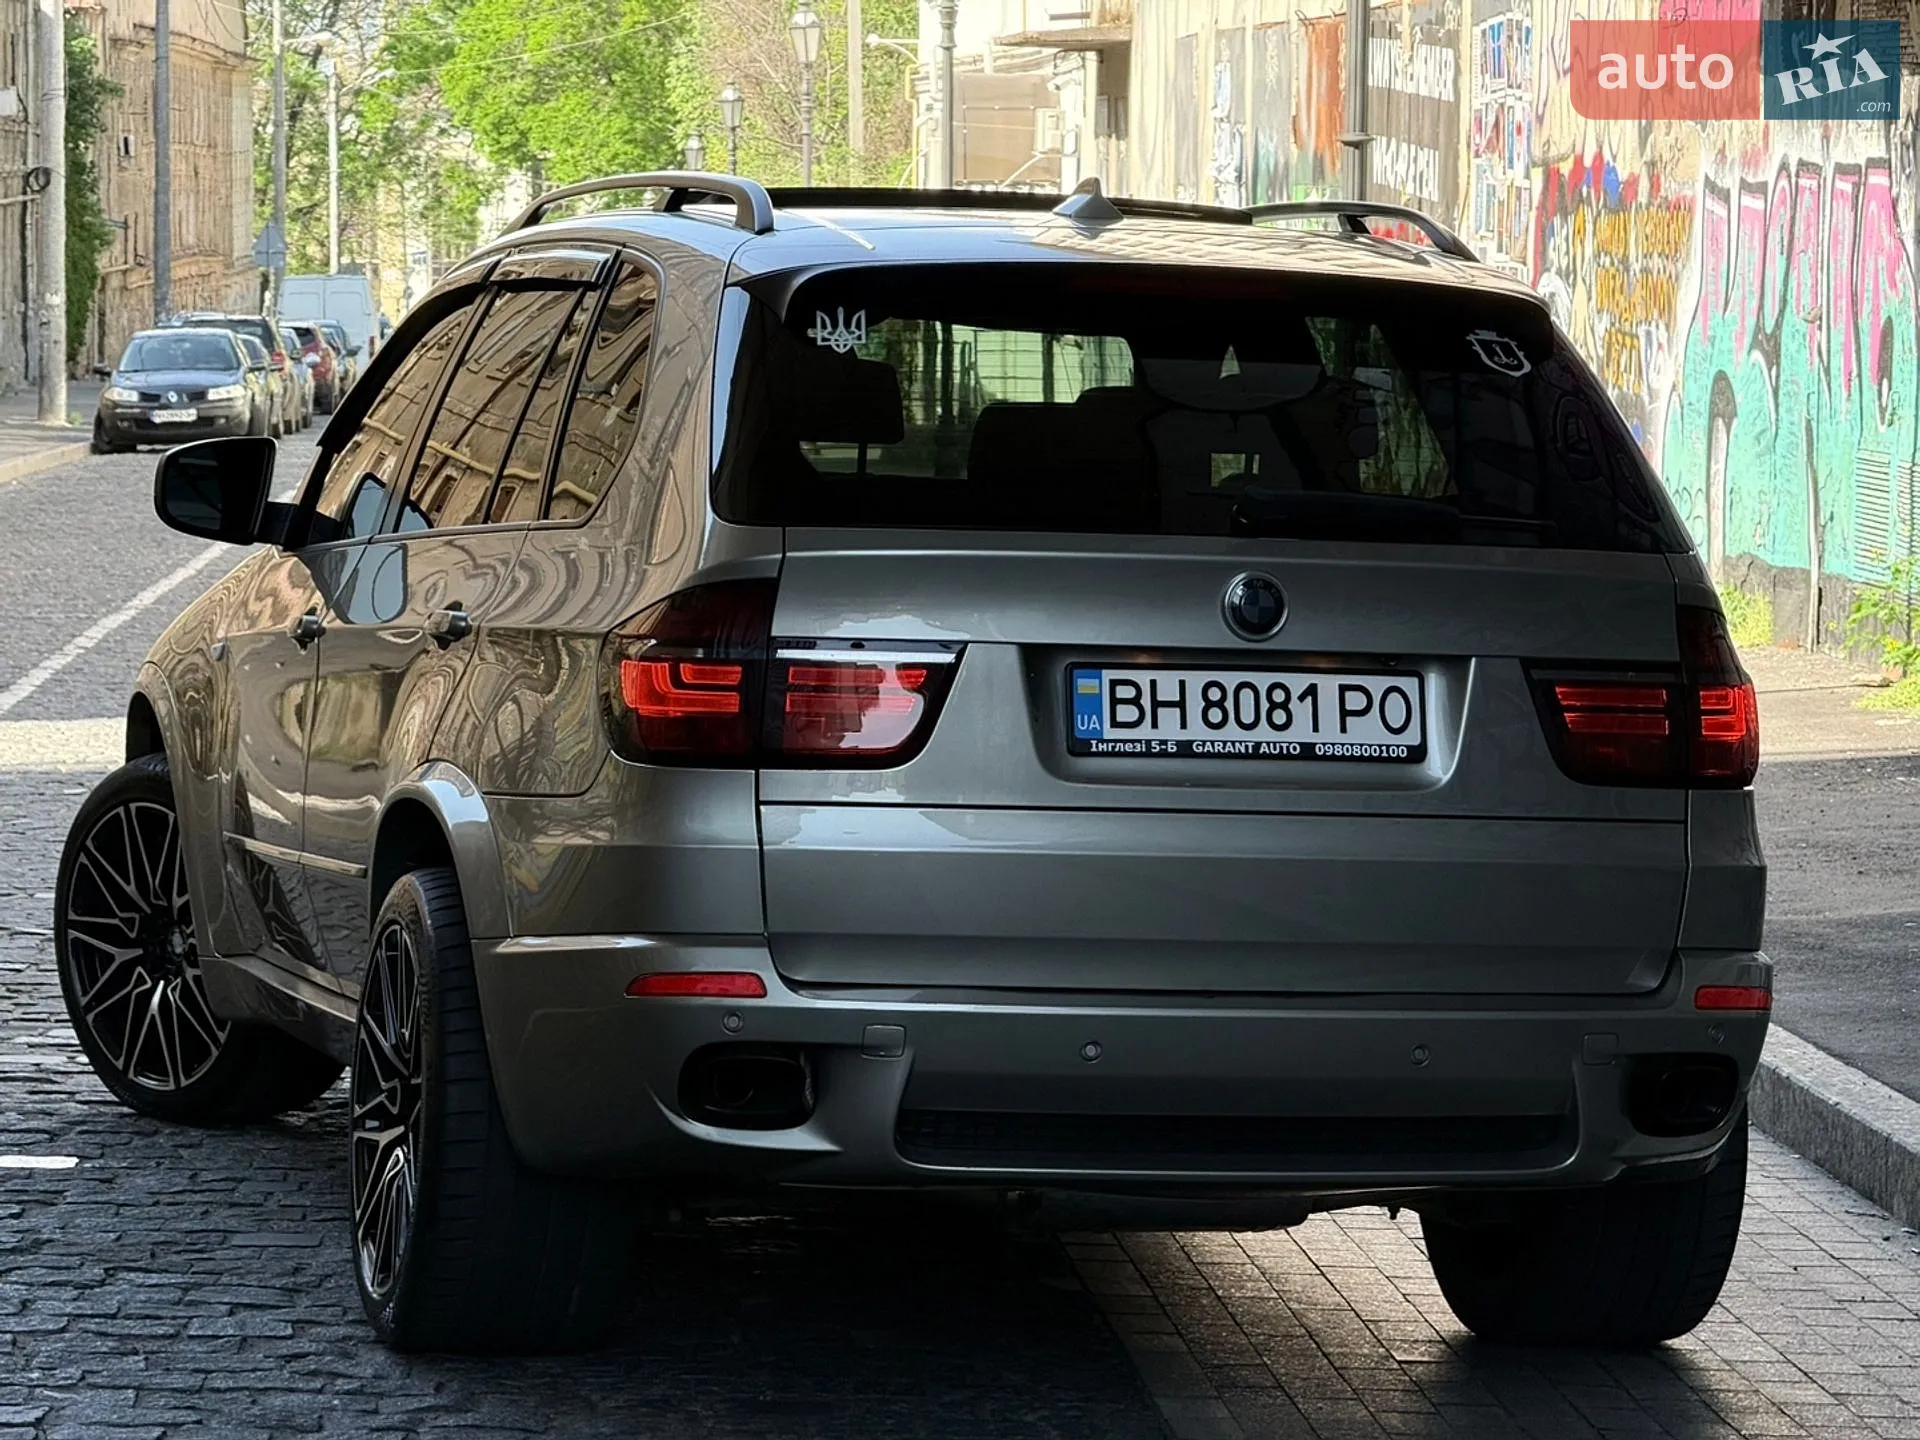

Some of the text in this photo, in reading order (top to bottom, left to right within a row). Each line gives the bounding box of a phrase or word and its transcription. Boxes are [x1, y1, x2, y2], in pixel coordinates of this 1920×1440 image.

[1108, 678, 1188, 730] BH
[1201, 680, 1319, 733] 8081
[1077, 715, 1100, 731] UA
[1090, 739, 1146, 752] Інглезі
[1192, 742, 1301, 755] GARANT AUTO
[1314, 743, 1408, 758] 0980800100
